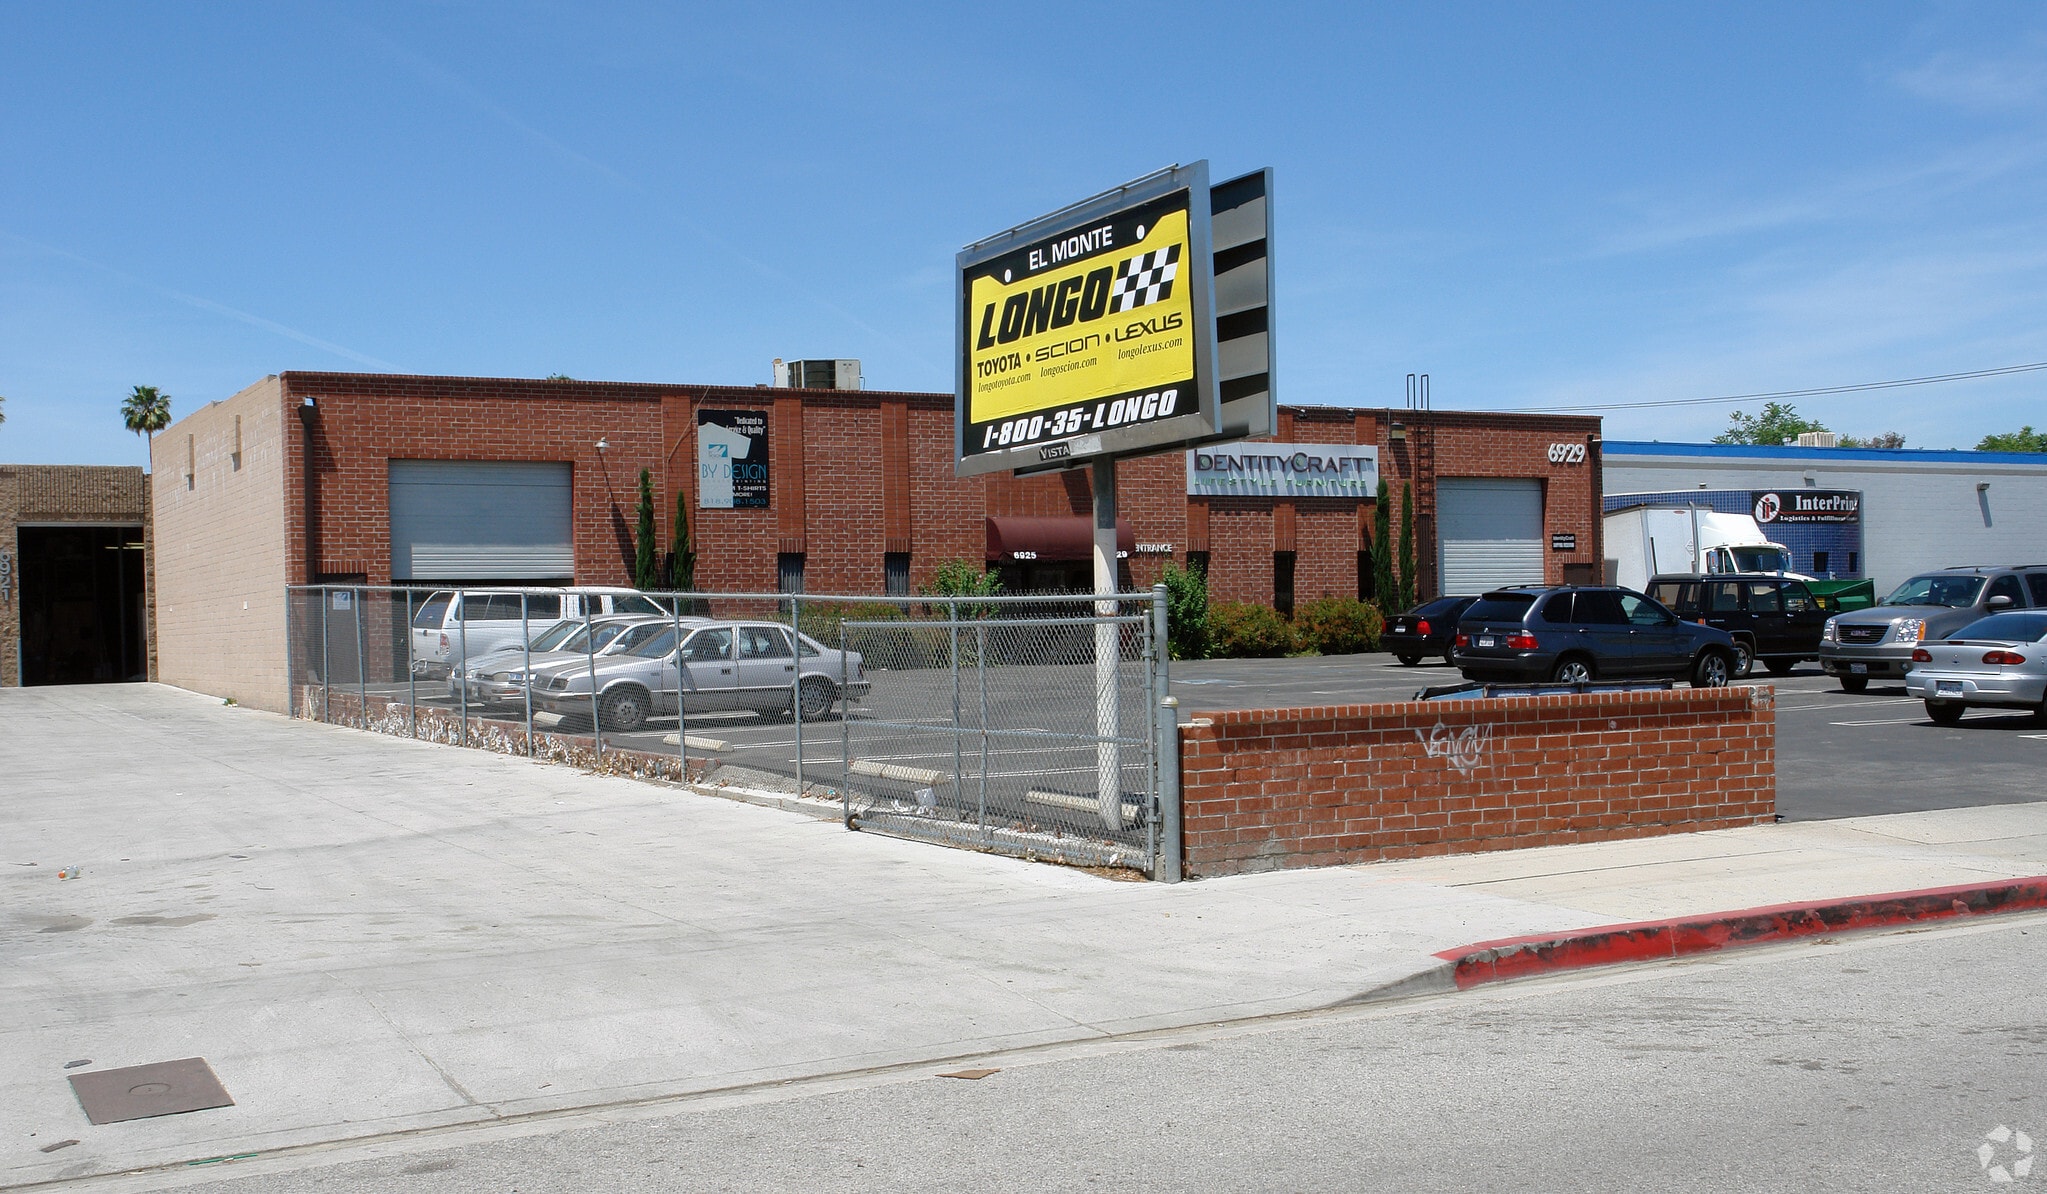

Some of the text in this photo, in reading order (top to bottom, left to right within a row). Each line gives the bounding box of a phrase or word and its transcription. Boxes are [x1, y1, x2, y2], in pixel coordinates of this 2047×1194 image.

[1029, 225, 1113, 271] EL MONTE
[976, 266, 1113, 351] LONGO
[977, 353, 1022, 378] TOYOTA
[1114, 312, 1183, 343] LEXUS
[977, 336, 1183, 393] longotoyota.com longoscion.com longolexus.com
[983, 388, 1178, 448] 1-800-35-LONGO
[1040, 444, 1070, 460] VISTA
[1547, 442, 1586, 464] 6929
[702, 464, 767, 479] BY DESIGN
[1193, 477, 1367, 488] LIFESTYLE FURNITURE
[1780, 515, 1810, 523] Logistics
[1013, 551, 1037, 560] 6925
